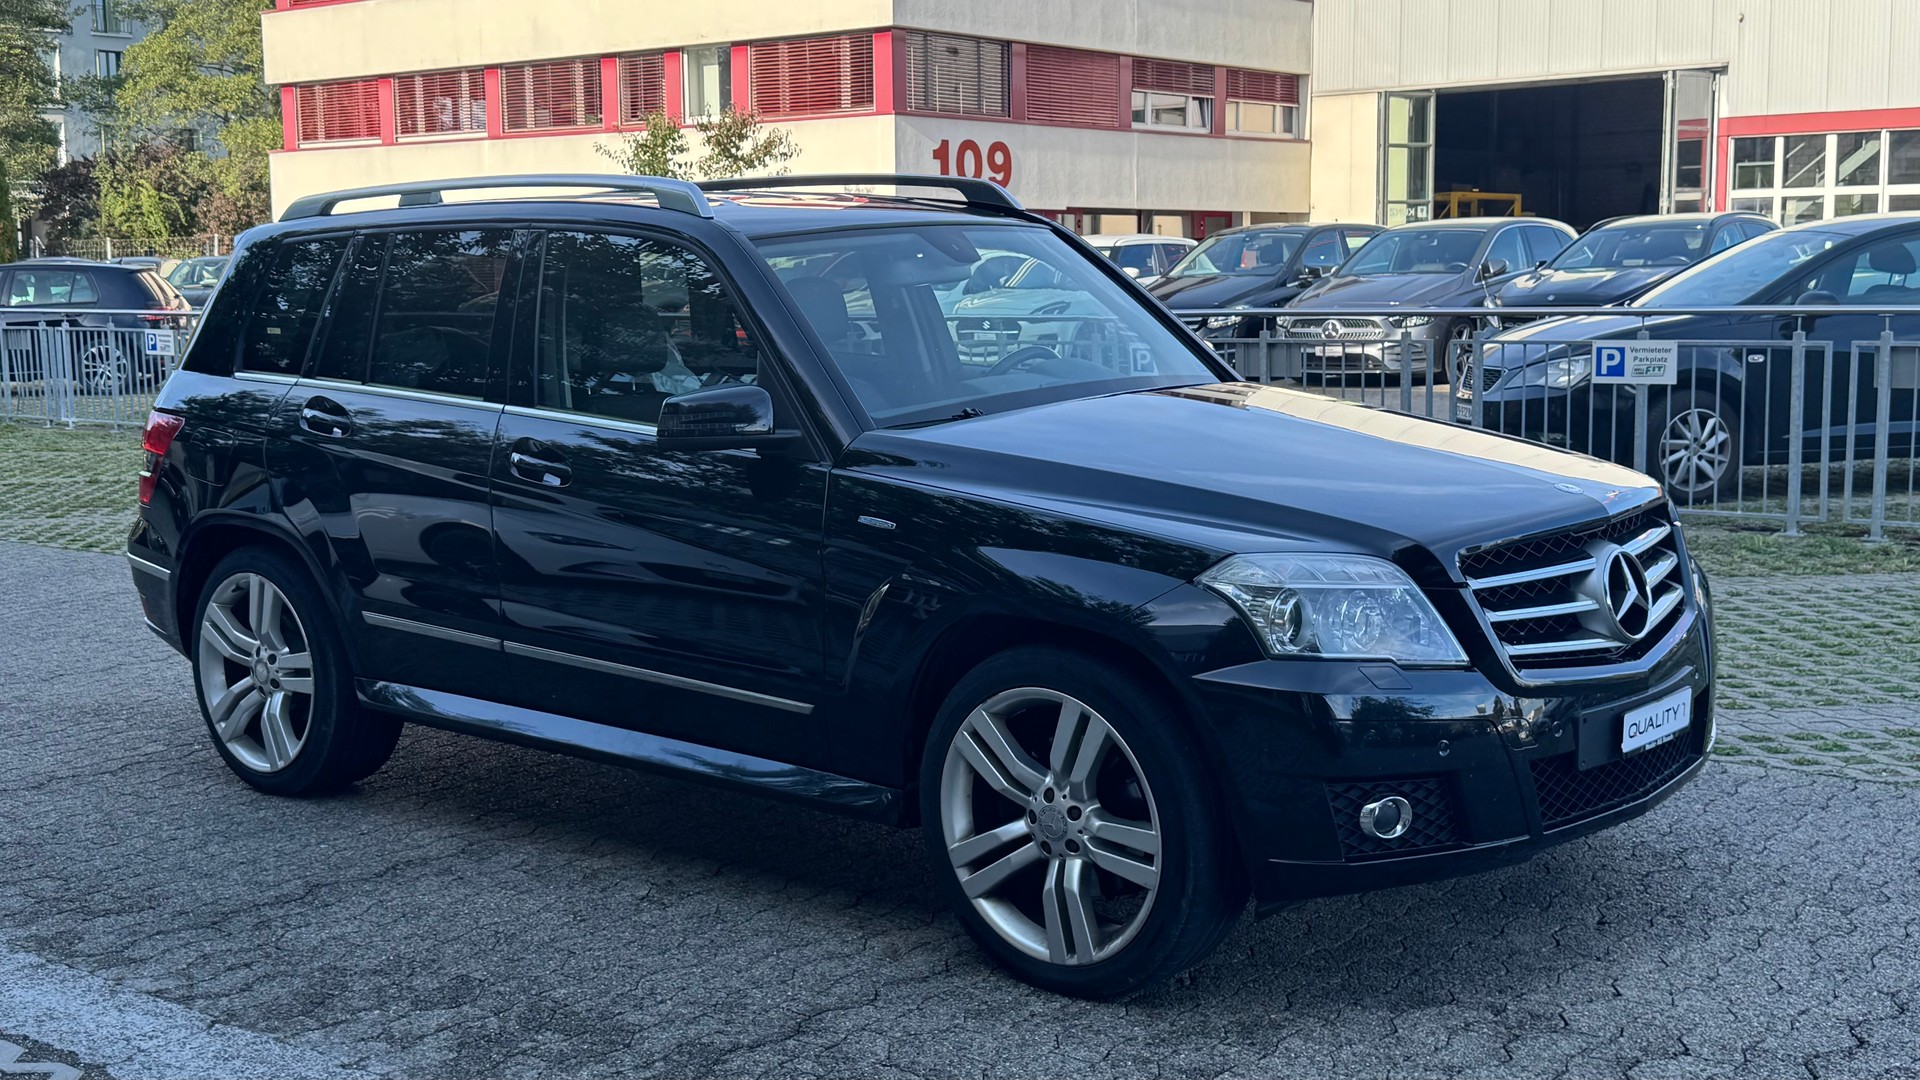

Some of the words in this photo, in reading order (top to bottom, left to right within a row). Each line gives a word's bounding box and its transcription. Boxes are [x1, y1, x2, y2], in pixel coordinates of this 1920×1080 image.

[933, 139, 1012, 188] 109
[148, 334, 156, 349] P
[1137, 350, 1150, 370] P
[1601, 349, 1621, 374] P
[1633, 356, 1667, 364] Parkplatz
[1645, 366, 1663, 375] FIT
[1628, 704, 1680, 738] QUALITY
[1682, 702, 1686, 716] 1
